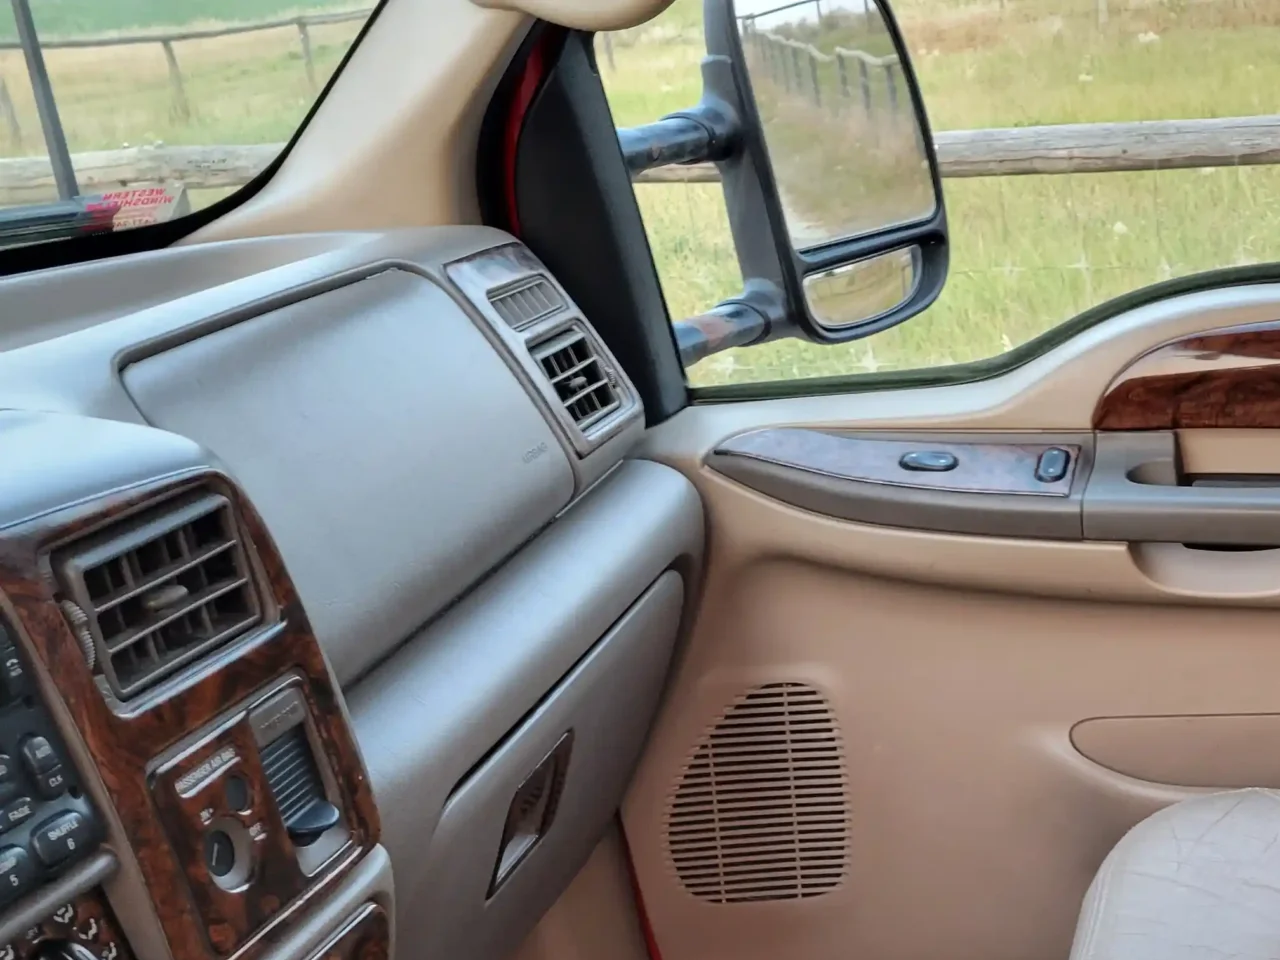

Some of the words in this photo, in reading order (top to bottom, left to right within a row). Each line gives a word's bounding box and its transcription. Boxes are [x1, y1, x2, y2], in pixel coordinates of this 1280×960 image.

[48, 774, 63, 788] CLK
[47, 820, 79, 841] SHUFFLE
[66, 838, 76, 850] 6
[9, 874, 19, 887] 5
